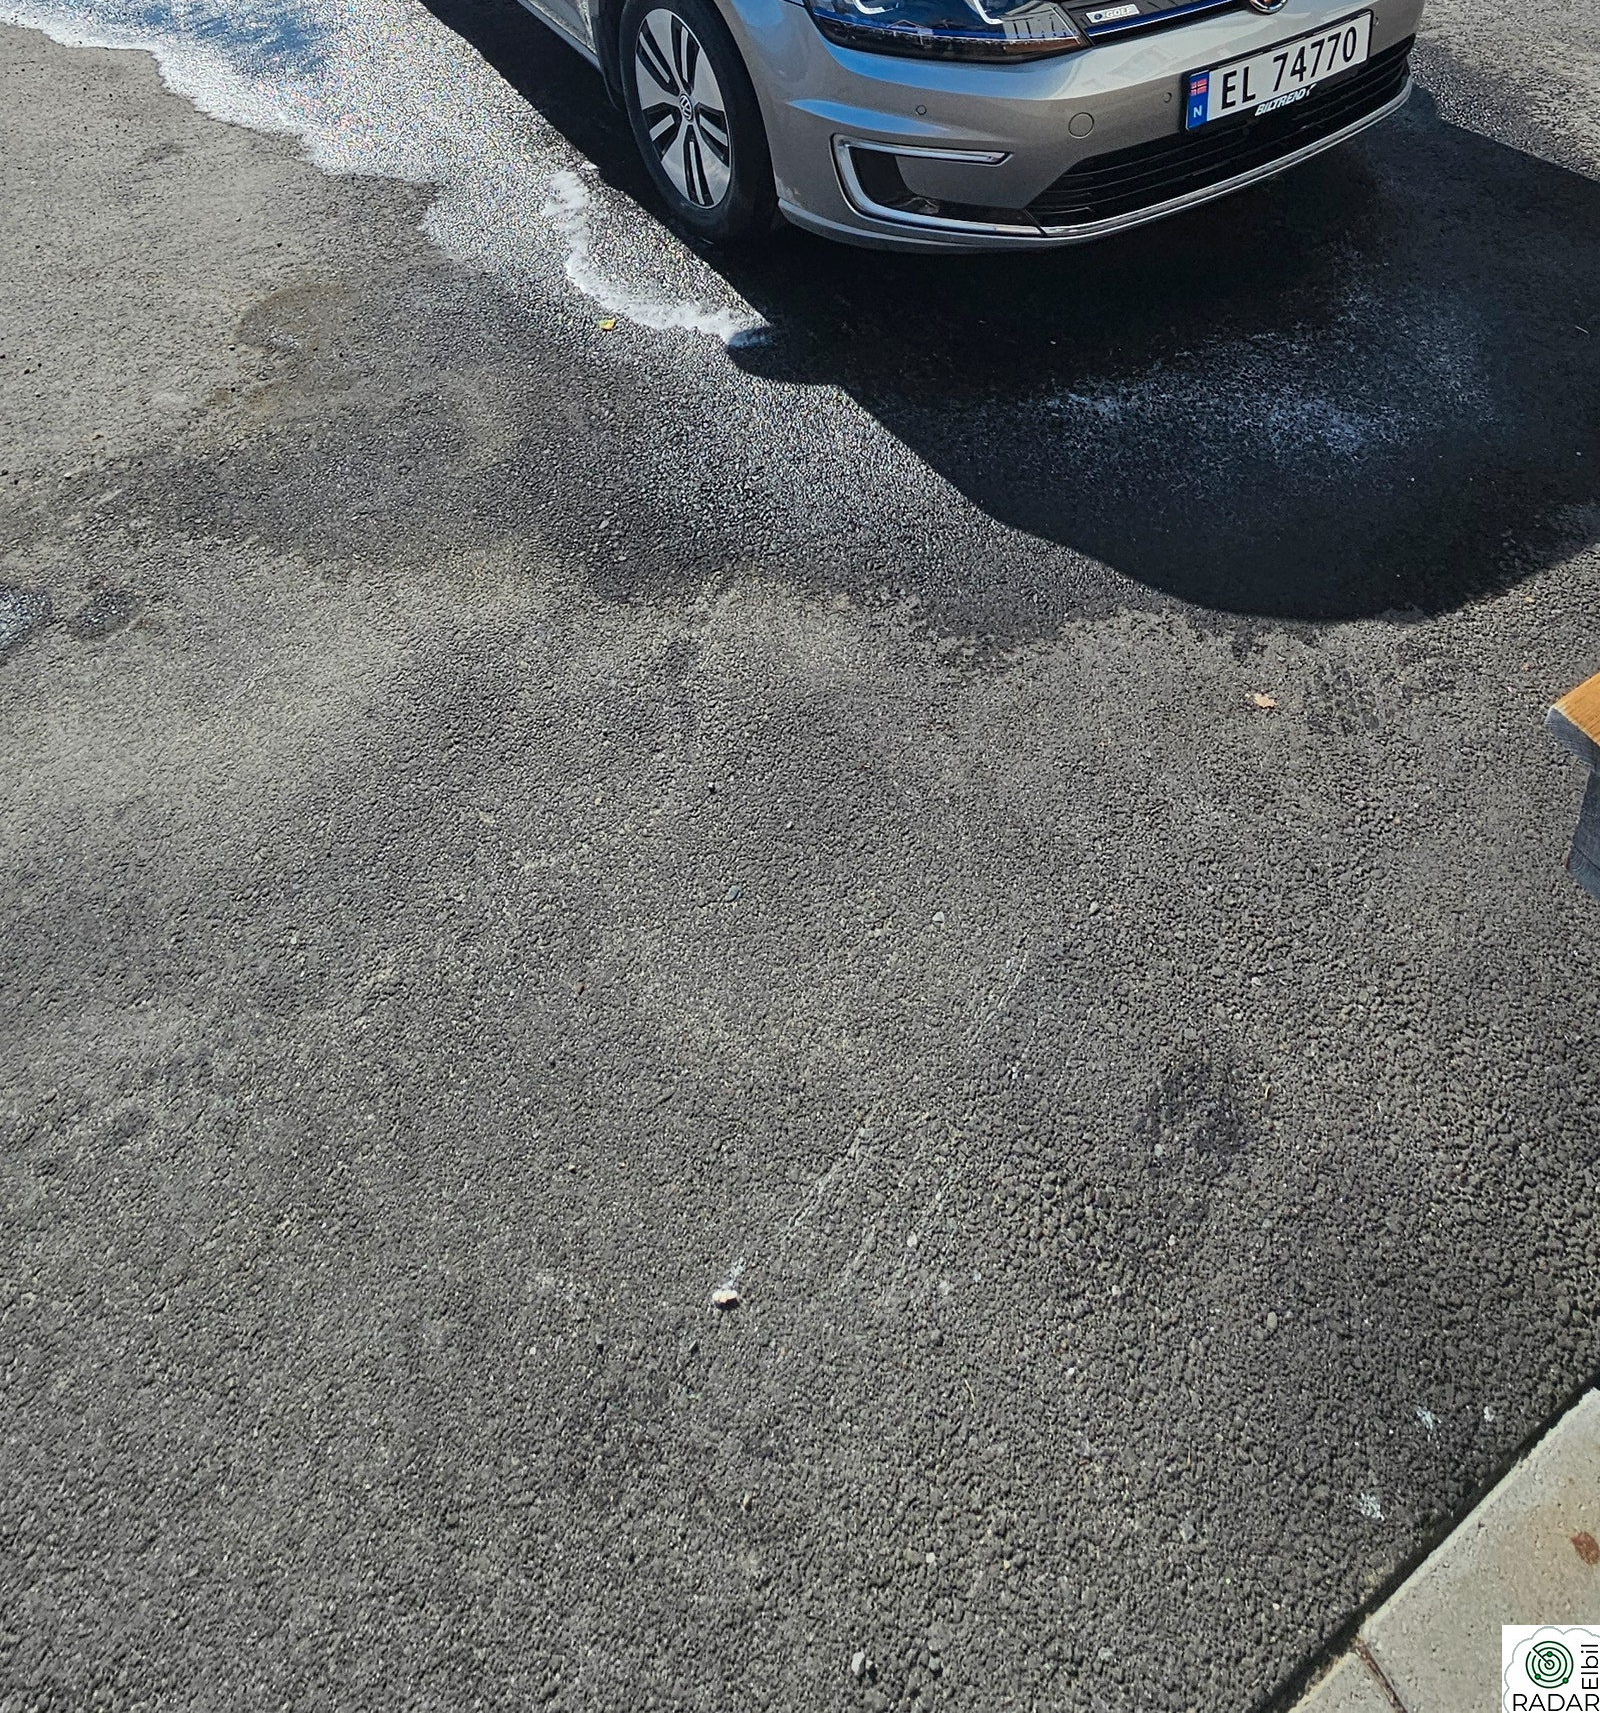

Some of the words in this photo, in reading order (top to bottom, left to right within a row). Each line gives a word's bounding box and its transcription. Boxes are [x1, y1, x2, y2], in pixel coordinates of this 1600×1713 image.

[1221, 66, 1256, 110] EL
[1272, 26, 1357, 92] 74770
[1193, 105, 1202, 118] N
[1254, 83, 1318, 117] BILTRENDY
